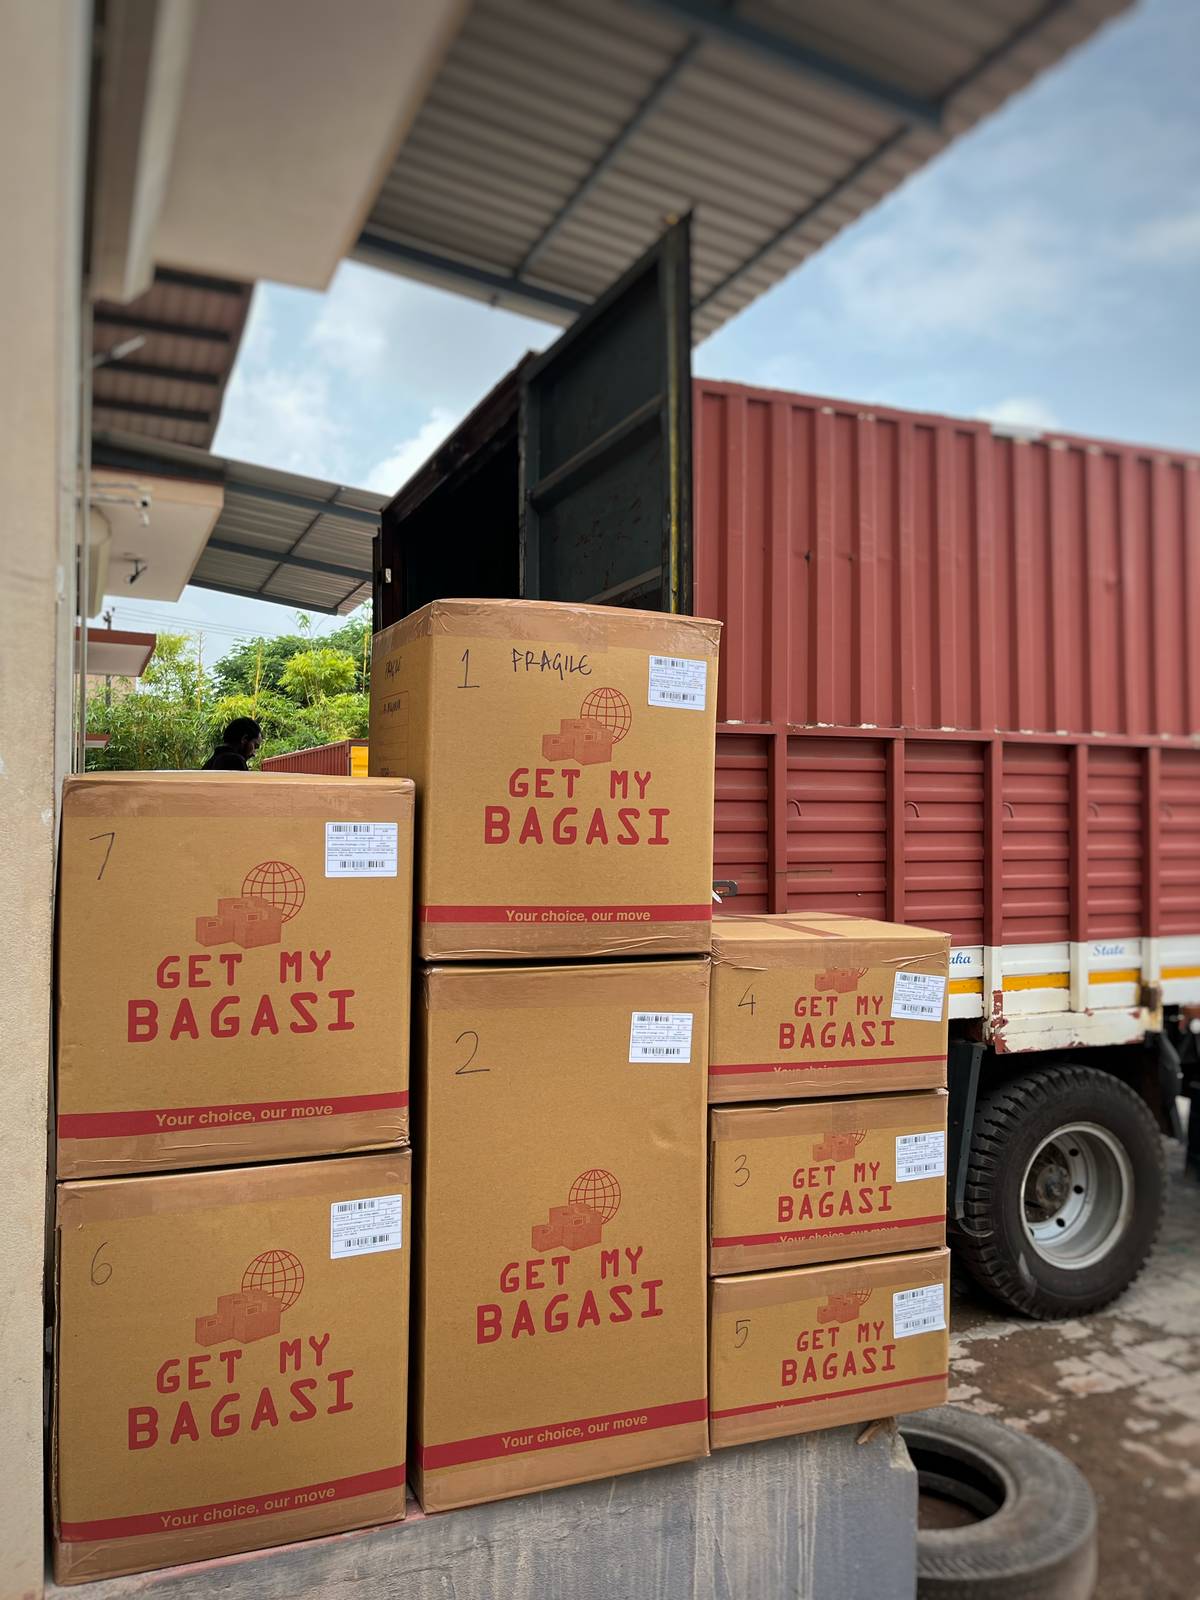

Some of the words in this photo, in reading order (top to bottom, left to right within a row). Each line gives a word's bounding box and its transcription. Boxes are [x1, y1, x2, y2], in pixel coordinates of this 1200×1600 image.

[457, 648, 480, 689] 1
[511, 647, 593, 681] FRAGILE
[508, 767, 580, 799] GET
[610, 769, 651, 800] MY
[484, 806, 670, 846] BAGASI
[89, 832, 116, 881] 7
[505, 909, 538, 922] Your
[541, 910, 589, 923] choice,
[591, 912, 614, 922] our
[616, 911, 651, 922] move
[949, 951, 972, 965] aka
[1092, 943, 1126, 956] State
[156, 953, 243, 989] GET
[279, 950, 332, 984] MY
[127, 988, 354, 1043] BAGASI
[738, 984, 757, 1016] 4
[794, 995, 839, 1018] GET
[856, 995, 884, 1017] MY
[455, 1030, 491, 1075] 2
[779, 1020, 896, 1050] BAGASI
[155, 1113, 195, 1127] Your
[199, 1109, 257, 1124] choice,
[260, 1107, 287, 1119] our
[291, 1103, 334, 1117] move
[733, 1154, 751, 1188] 3
[792, 1165, 836, 1189] GET
[854, 1160, 881, 1184] MY
[778, 1185, 893, 1223] BAGASI
[91, 1241, 113, 1286] 6
[500, 1255, 571, 1293] GET
[600, 1246, 644, 1279] MY
[476, 1278, 663, 1345] BAGASI
[735, 1319, 751, 1349] 5
[796, 1326, 840, 1352] GET
[857, 1320, 885, 1344] MY
[156, 1349, 243, 1394] GET
[279, 1333, 331, 1373] MY
[781, 1344, 897, 1387] BAGASI
[127, 1369, 353, 1449] BAGASI
[502, 1433, 534, 1449] Your
[537, 1425, 584, 1442] choice,
[587, 1422, 610, 1434] our
[613, 1414, 648, 1429] move
[160, 1513, 199, 1528] Your
[203, 1504, 260, 1522] choice,
[264, 1496, 291, 1511] our
[294, 1487, 336, 1504] move
